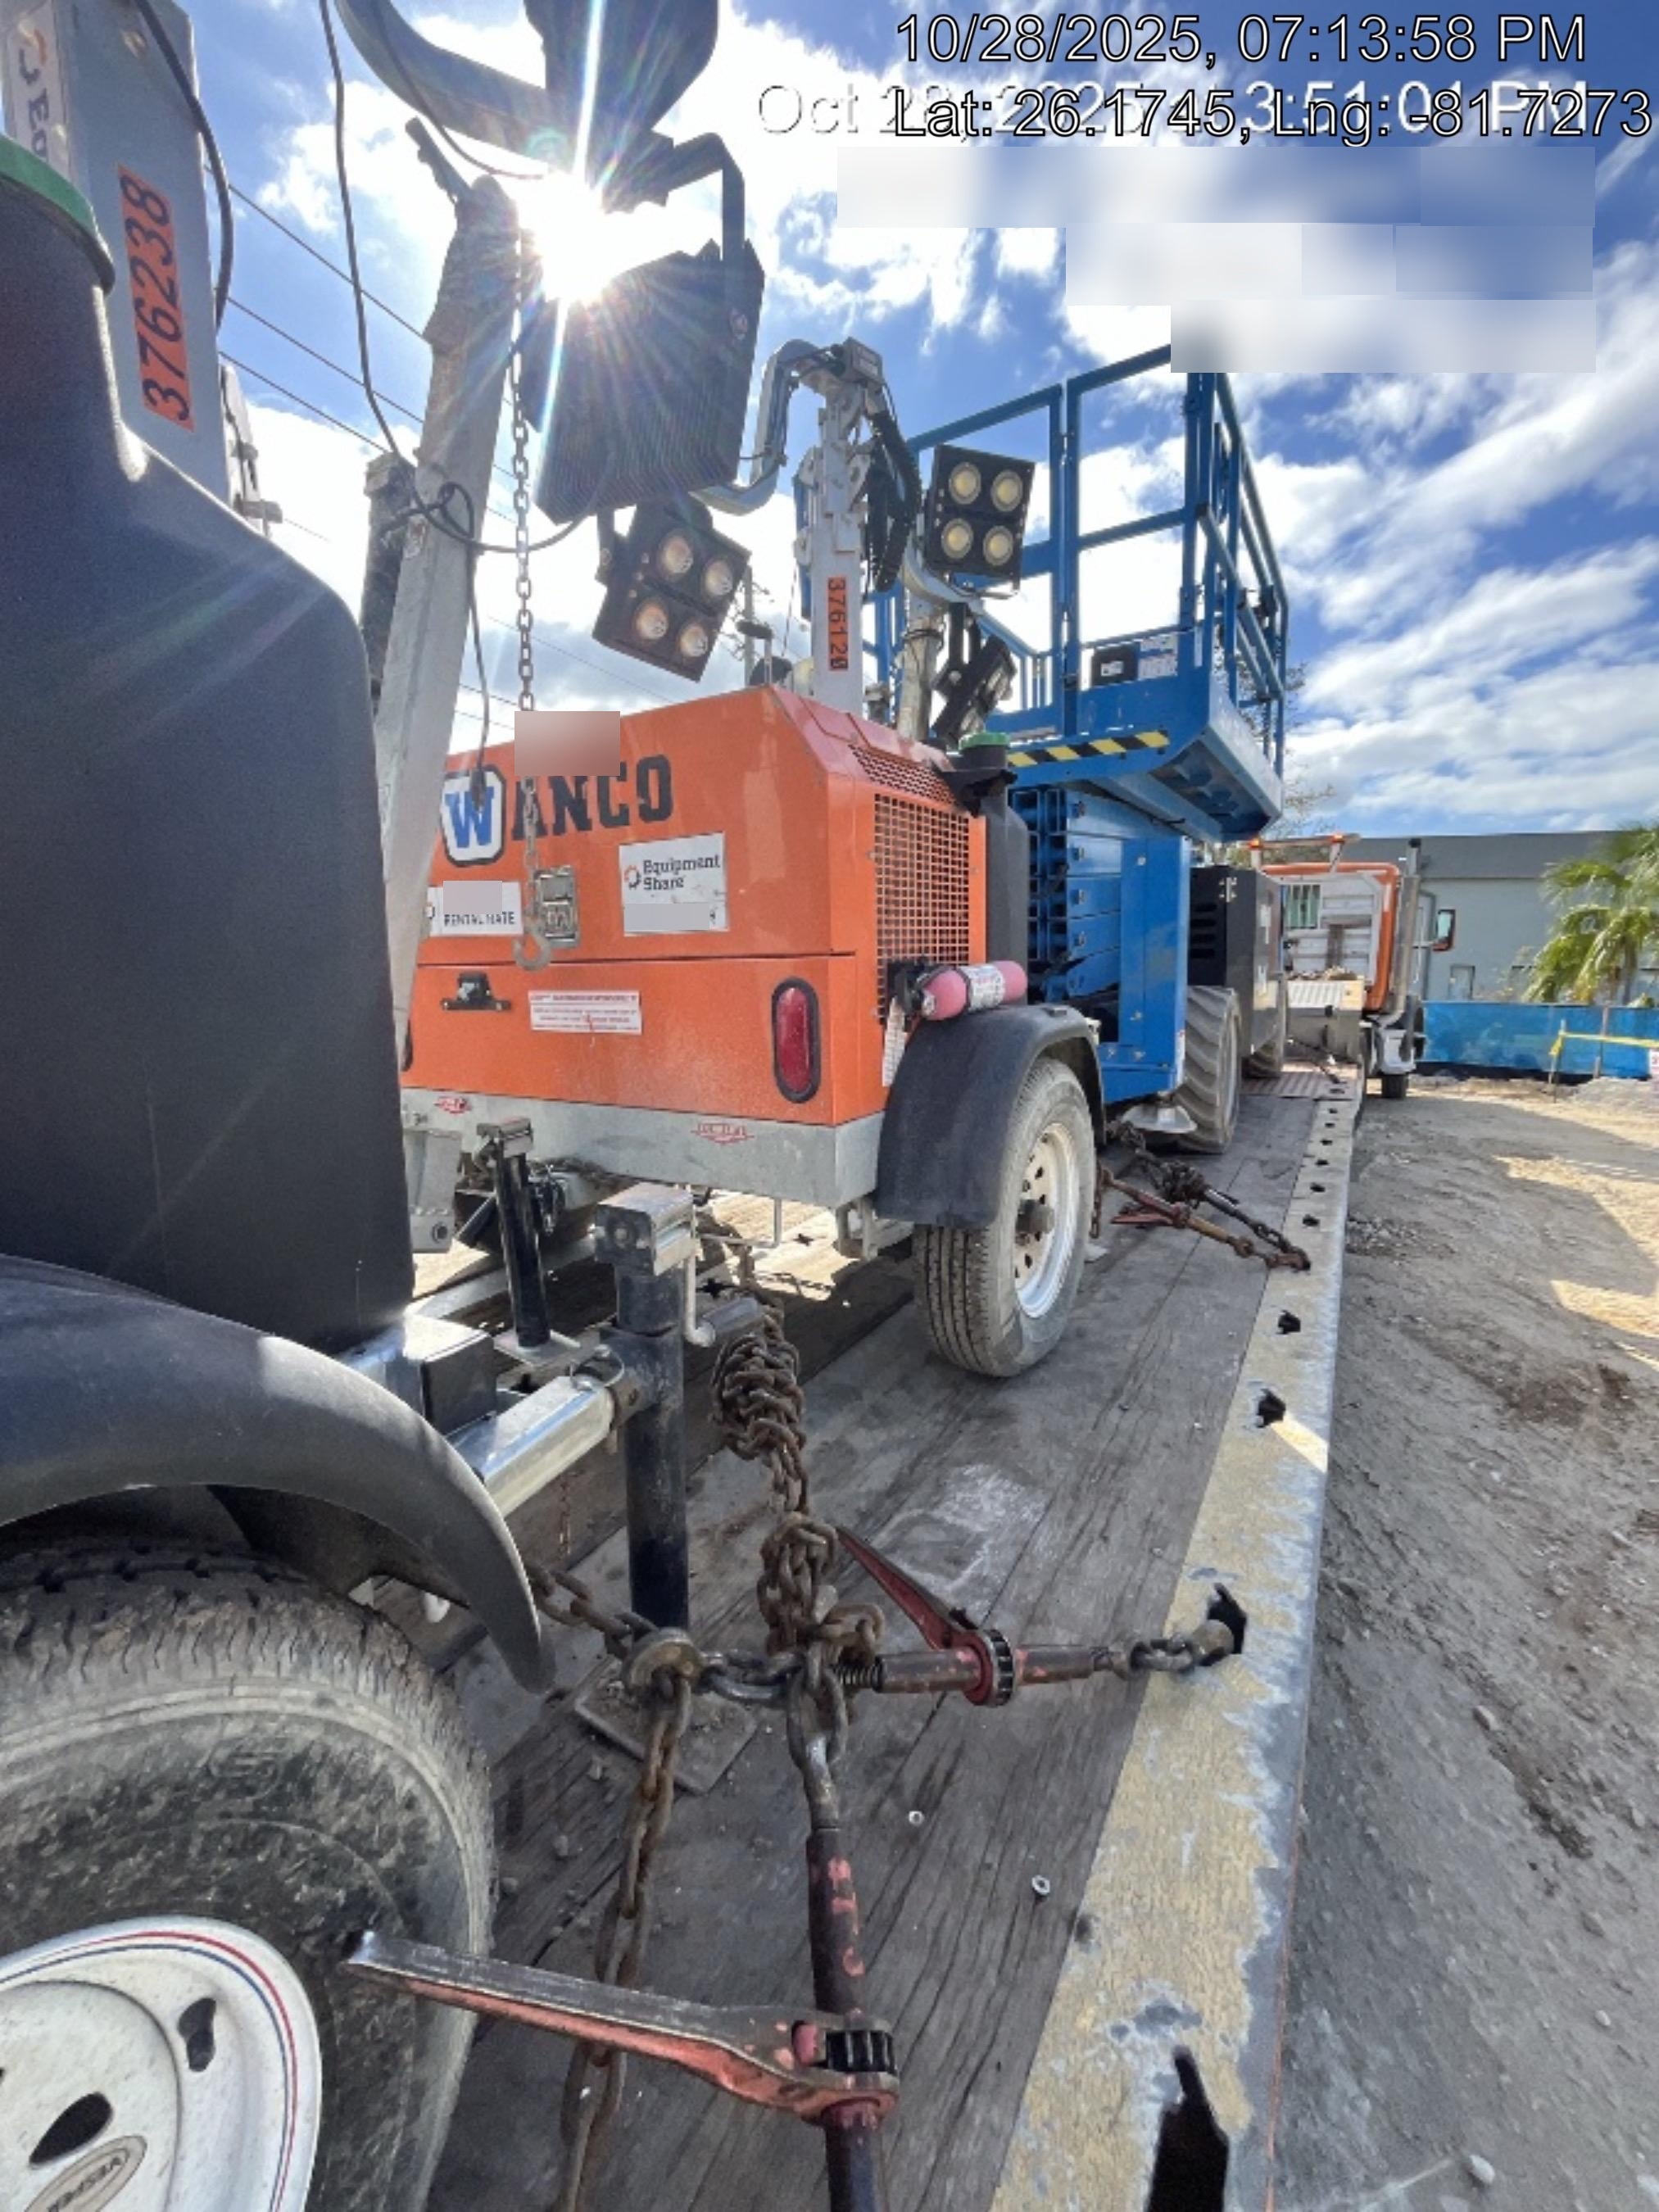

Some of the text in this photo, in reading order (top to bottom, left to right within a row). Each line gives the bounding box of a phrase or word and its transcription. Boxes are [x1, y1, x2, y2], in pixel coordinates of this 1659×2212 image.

[120, 175, 190, 420] 376238
[642, 854, 721, 876] Equipment
[642, 877, 684, 891] Share
